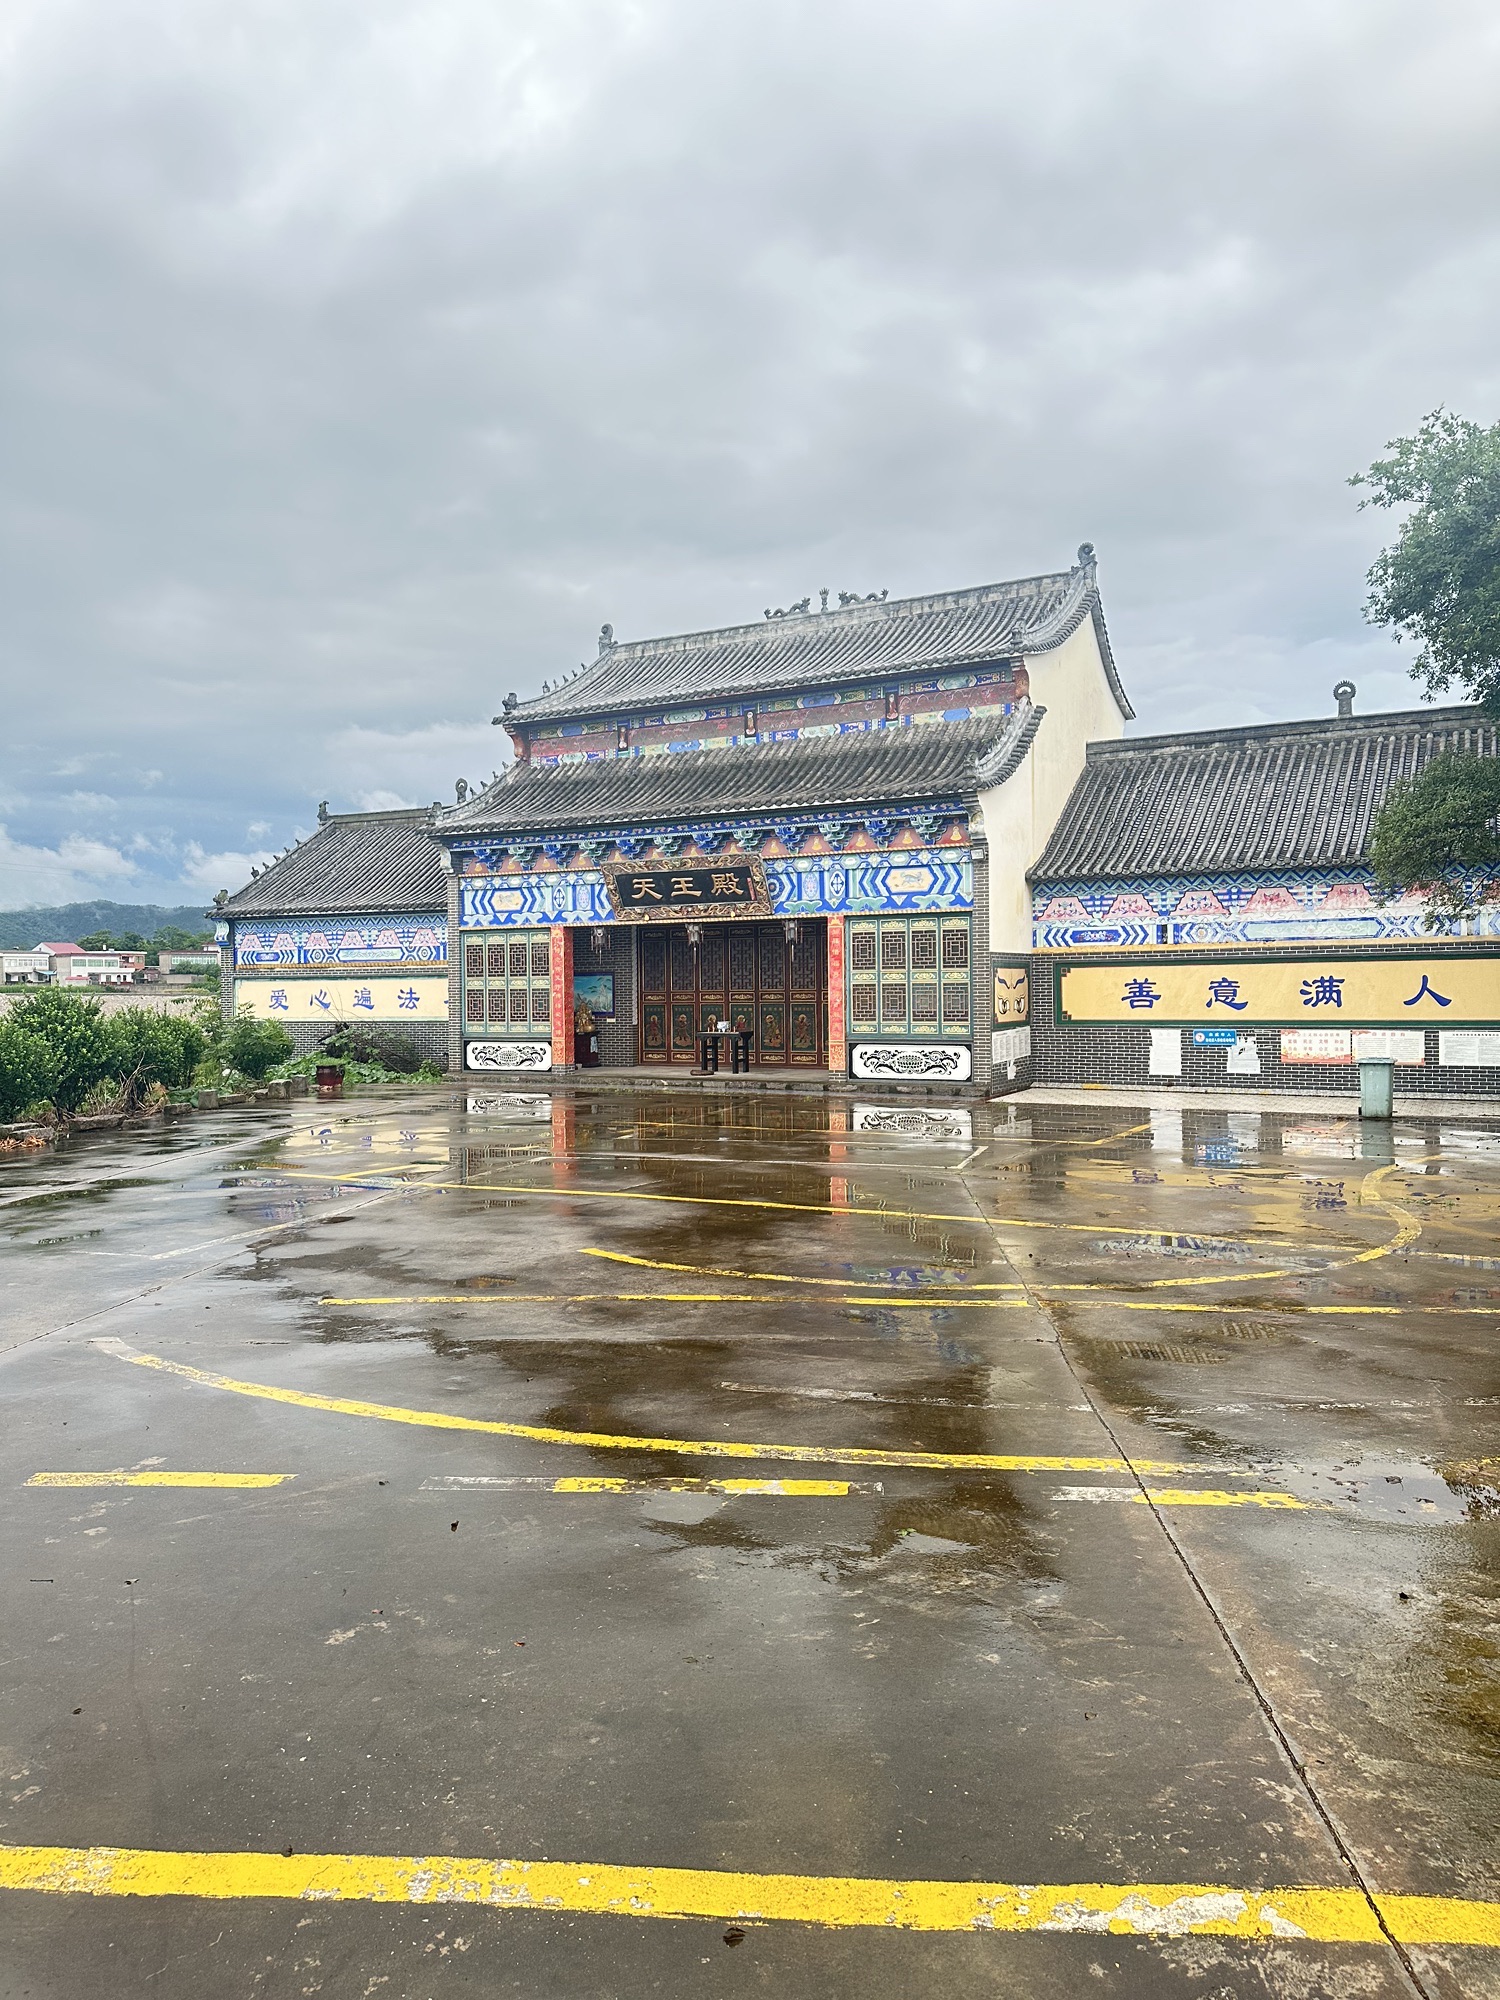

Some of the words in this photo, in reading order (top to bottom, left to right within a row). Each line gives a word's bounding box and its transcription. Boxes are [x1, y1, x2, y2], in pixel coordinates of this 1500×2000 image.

[631, 872, 744, 900] 天王殿
[268, 986, 449, 1011] 爱心遍法
[1121, 974, 1452, 1011] 善意满人
